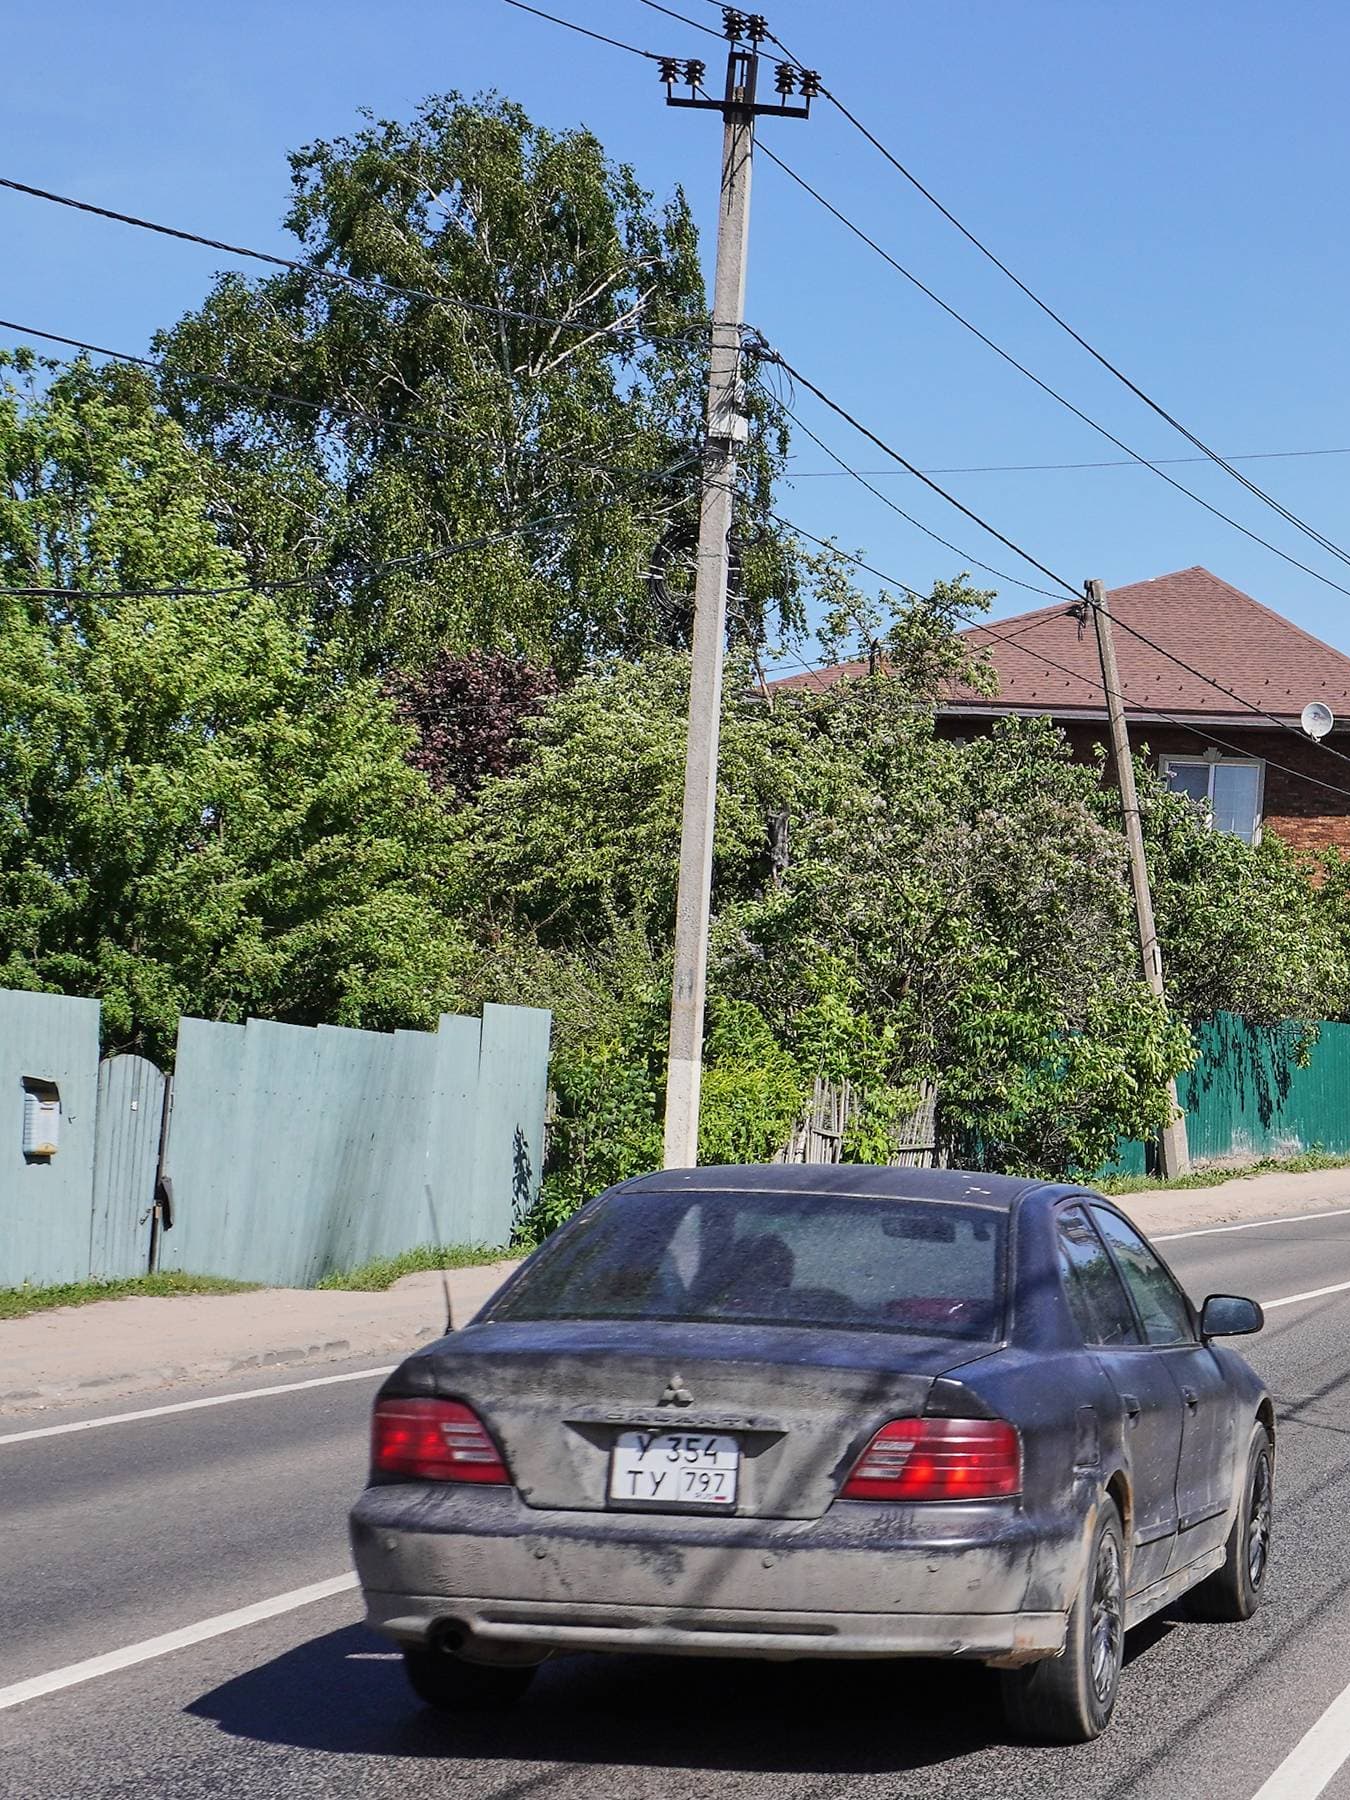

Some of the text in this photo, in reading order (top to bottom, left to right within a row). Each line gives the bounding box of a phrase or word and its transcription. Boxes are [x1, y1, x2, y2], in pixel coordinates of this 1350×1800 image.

[666, 1437, 719, 1465] 354
[627, 1469, 725, 1497] ТУ 797
